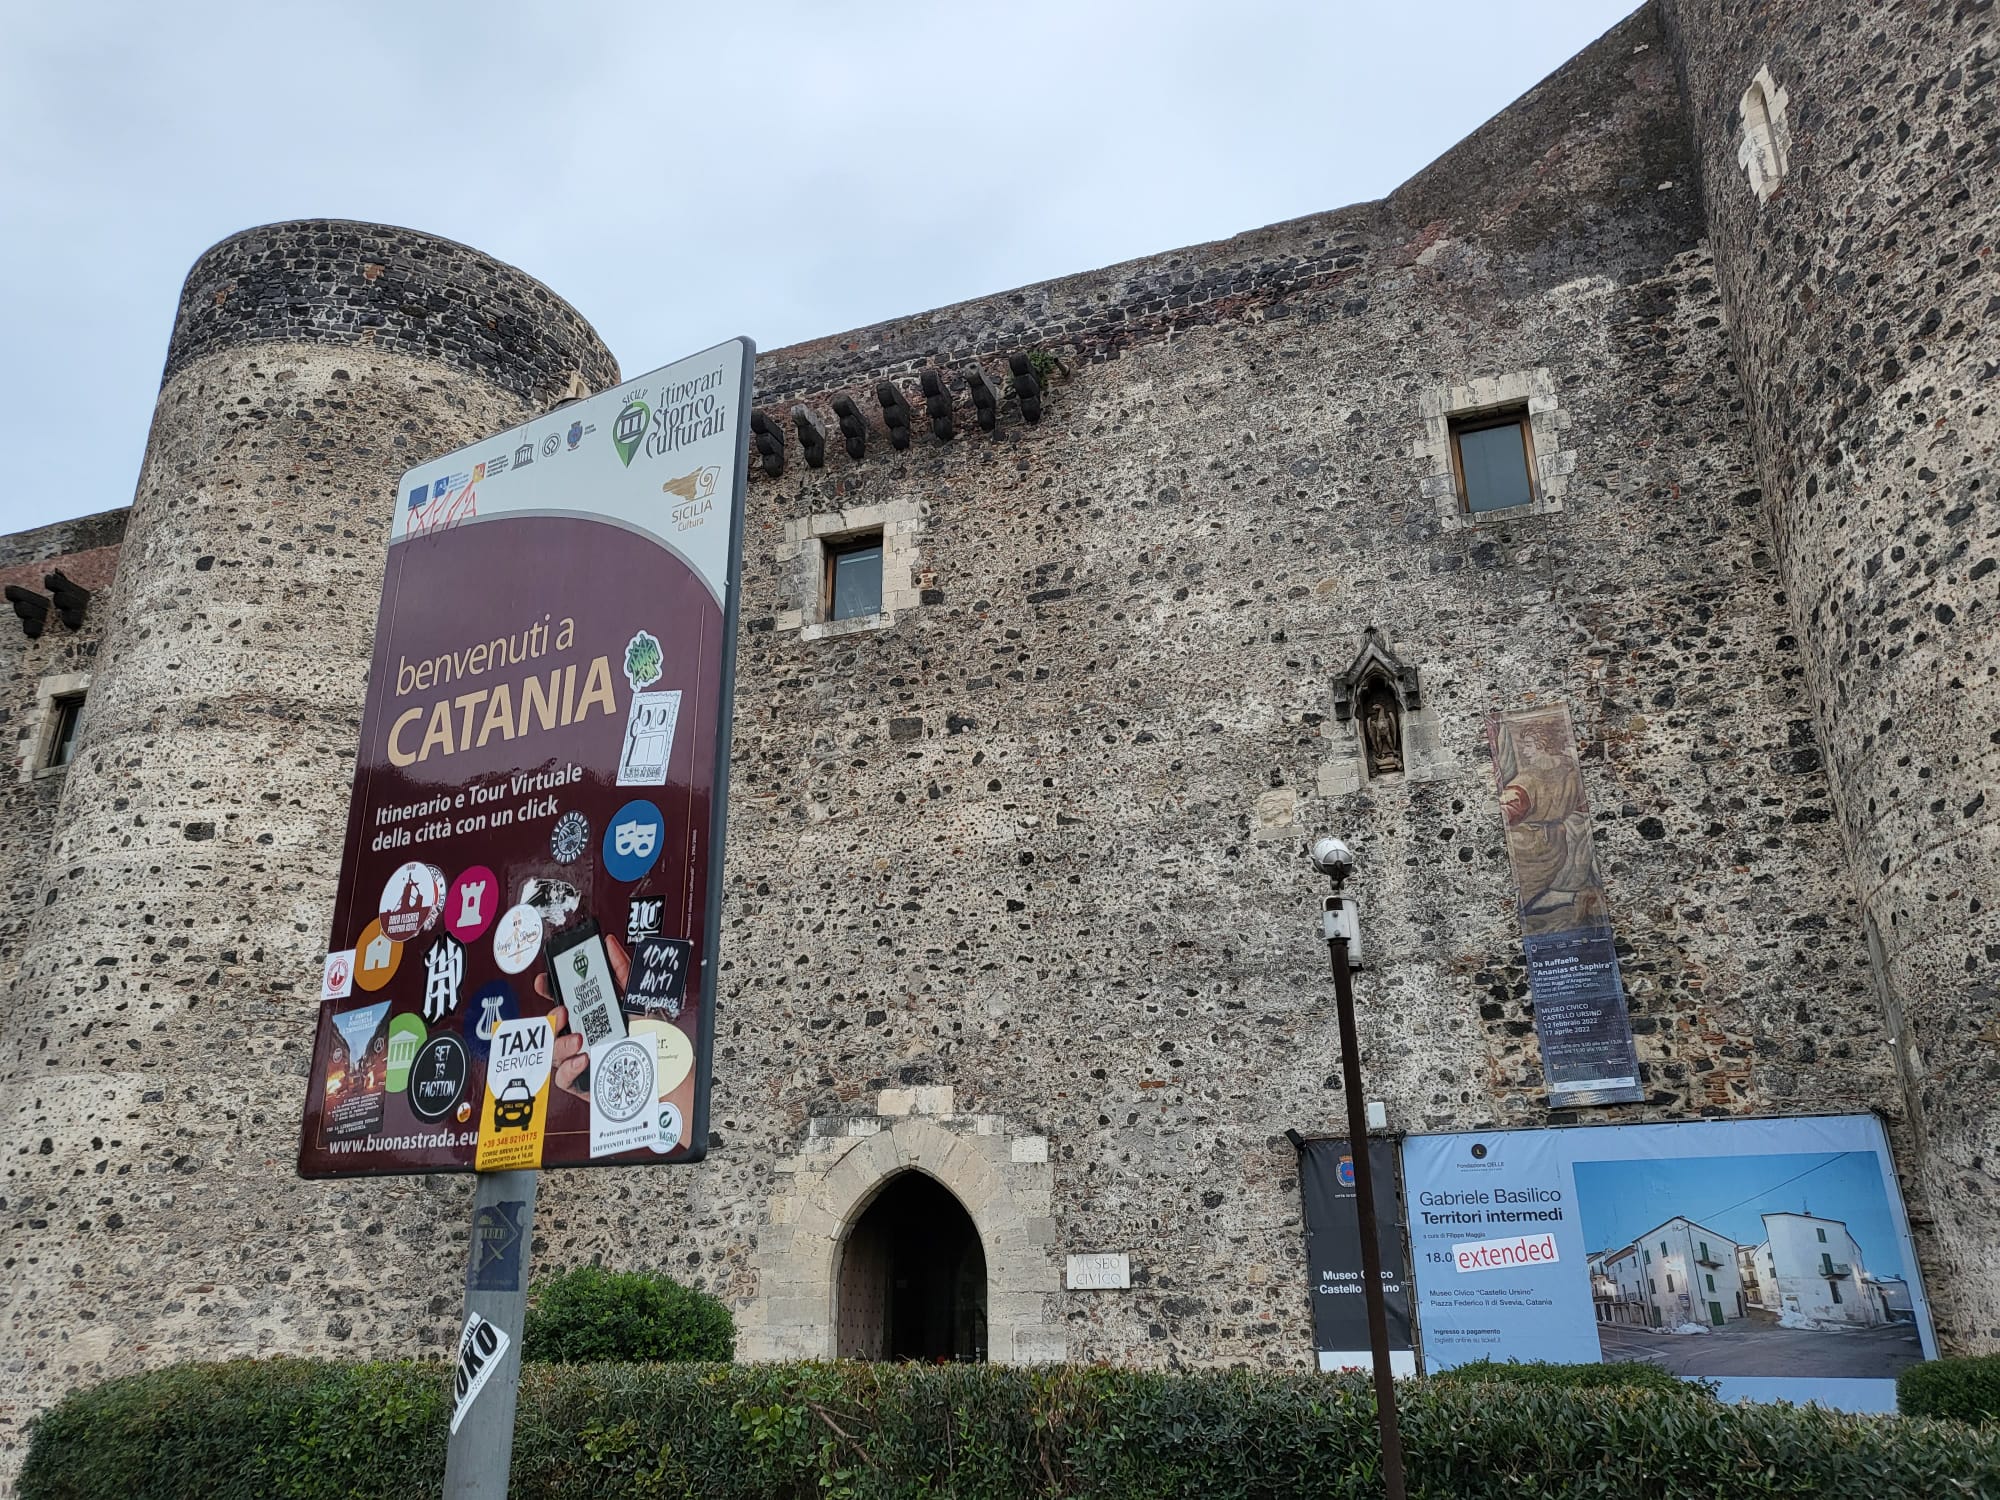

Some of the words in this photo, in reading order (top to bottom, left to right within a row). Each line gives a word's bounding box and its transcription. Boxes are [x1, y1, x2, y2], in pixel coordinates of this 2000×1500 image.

[622, 389, 648, 405] SICILY
[652, 394, 714, 434] Storico
[646, 405, 725, 458] Culturali
[672, 500, 712, 523] SICILIA
[678, 518, 704, 531] Cultura
[395, 613, 550, 696] benvenuti
[556, 617, 574, 651] a
[387, 656, 616, 768] CATANIA
[376, 794, 450, 826] Itinerario
[455, 792, 464, 808] e
[468, 783, 507, 806] Tour
[511, 763, 582, 796] Virtuale
[372, 827, 410, 851] della
[415, 817, 450, 843] città
[456, 814, 486, 834] con
[491, 809, 513, 828] un
[518, 794, 558, 821] click
[1545, 956, 1579, 967] Raffaello
[1541, 1006, 1564, 1014] MUSEO
[1542, 1013, 1574, 1021] CASTELLO
[1554, 1027, 1573, 1036] aprile
[499, 1025, 546, 1057] TAXI
[434, 1045, 451, 1062] SET
[436, 1063, 446, 1079] IS
[496, 1052, 544, 1073] SERVICE
[419, 1080, 455, 1098] FACTION
[329, 1128, 479, 1154] www.buonastrada.eu
[634, 1133, 656, 1143] VERBO
[1419, 1191, 1488, 1206] Gabriele
[1495, 1189, 1561, 1204] Basilico
[1422, 1210, 1481, 1225] Territori
[1487, 1208, 1563, 1222] intermedi
[1426, 1252, 1454, 1262] 18.0
[1459, 1235, 1555, 1268] extended
[1076, 1256, 1120, 1270] MUSEO
[1076, 1273, 1120, 1285] CIVICO
[1323, 1270, 1358, 1280] Museo
[1320, 1284, 1362, 1294] Castello
[1382, 1282, 1399, 1292] ino
